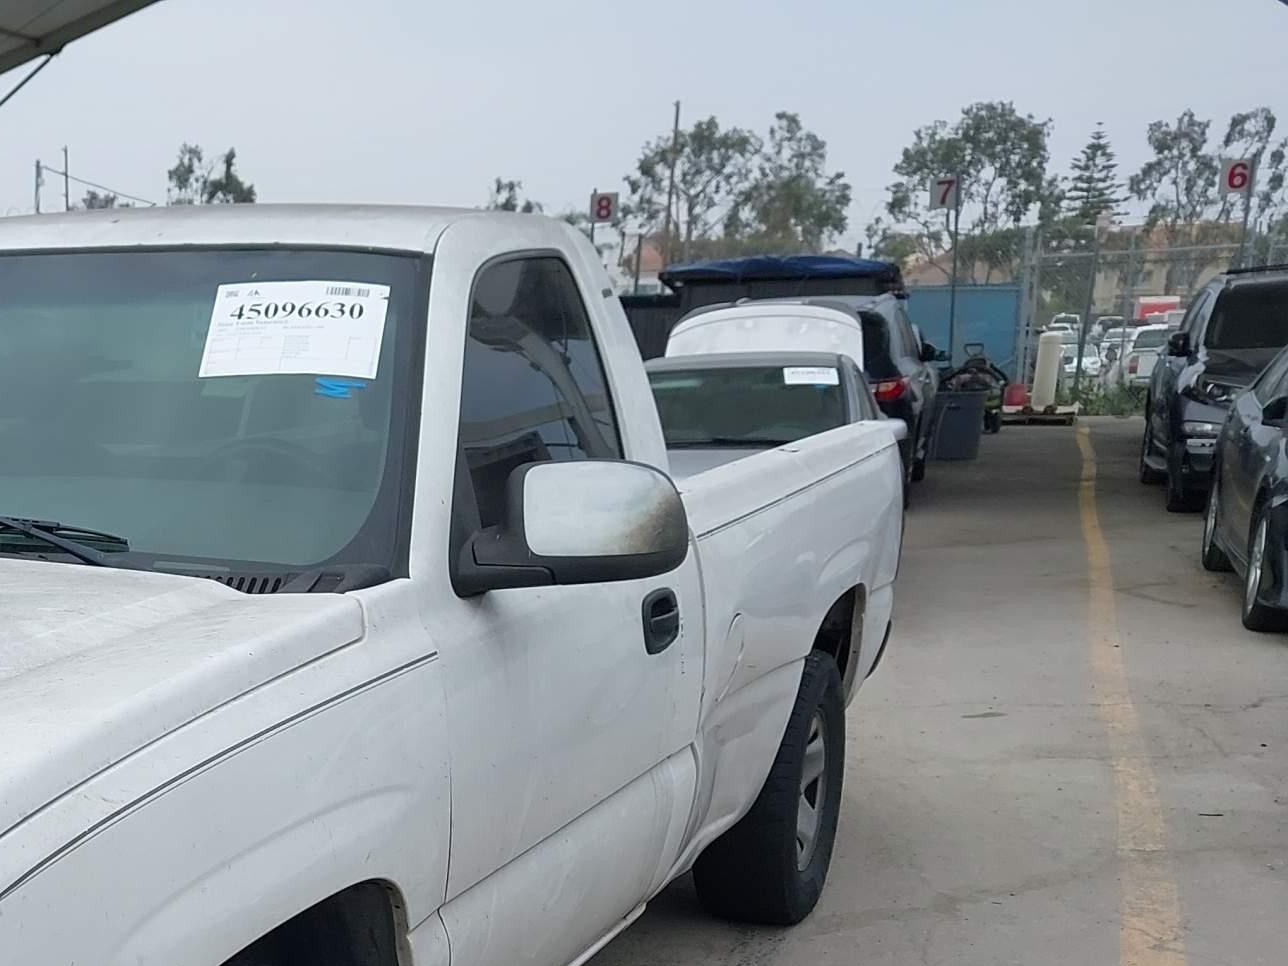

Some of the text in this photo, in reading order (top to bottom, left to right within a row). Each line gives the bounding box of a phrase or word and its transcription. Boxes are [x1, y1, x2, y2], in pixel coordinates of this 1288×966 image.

[1228, 163, 1249, 189] 6
[937, 180, 955, 205] 7
[597, 196, 612, 219] 8
[230, 302, 364, 320] 45096630
